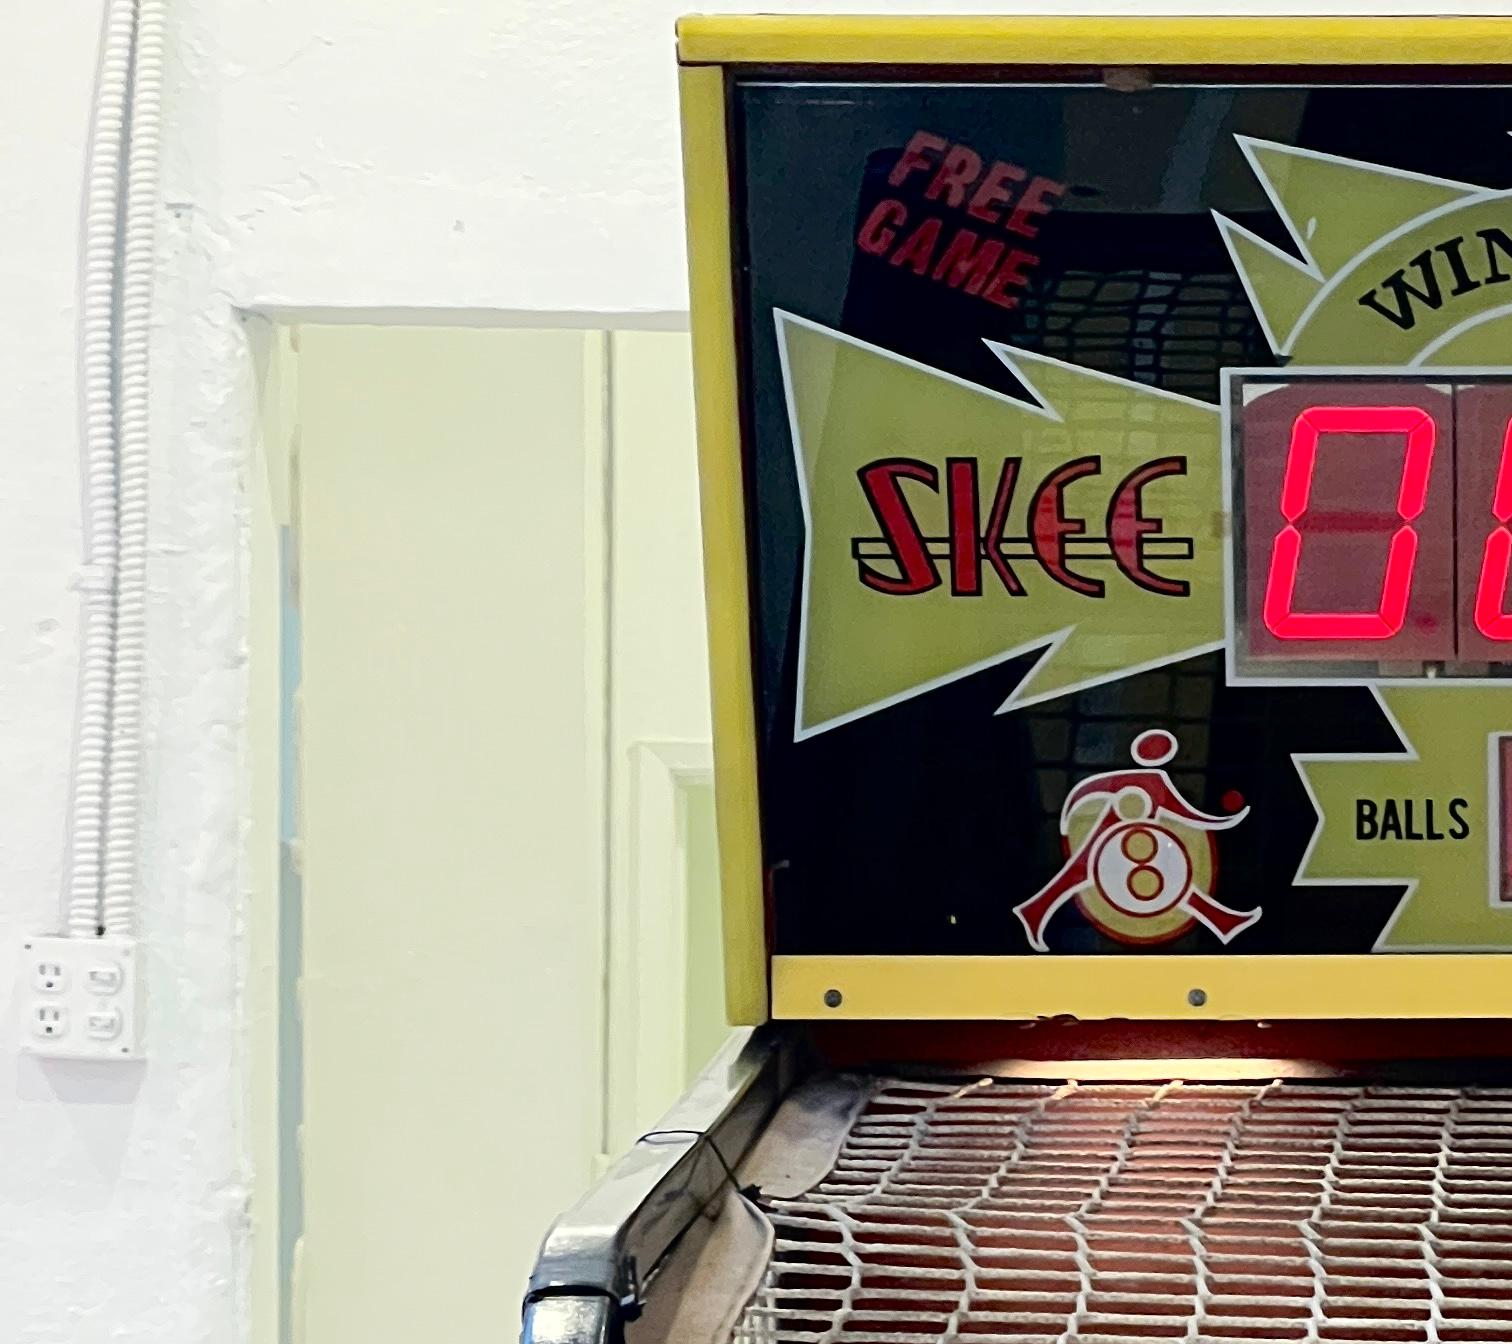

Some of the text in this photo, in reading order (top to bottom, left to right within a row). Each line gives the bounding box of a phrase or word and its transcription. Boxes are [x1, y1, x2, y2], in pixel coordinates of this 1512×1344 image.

[889, 130, 1066, 239] FREE
[858, 201, 1041, 309] GAME
[853, 455, 1193, 597] SKEE
[1120, 824, 1165, 902] 8
[1355, 799, 1470, 843] BALLS
